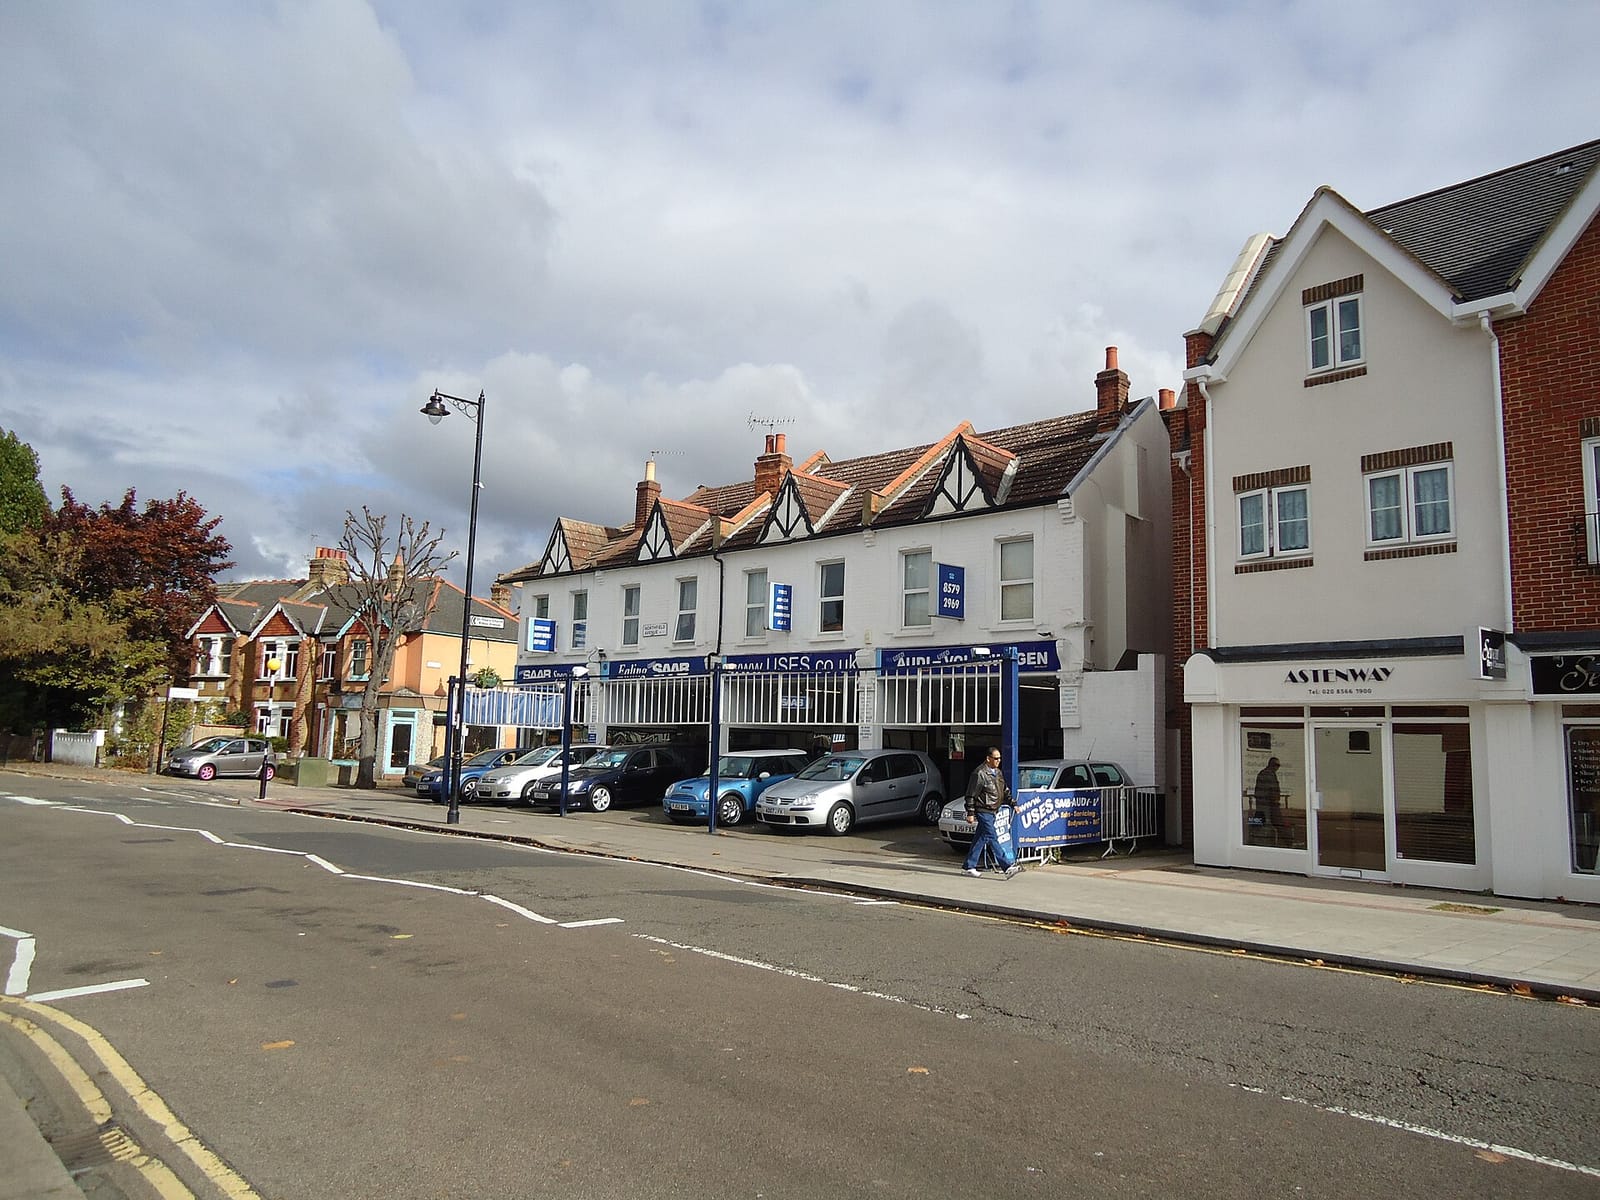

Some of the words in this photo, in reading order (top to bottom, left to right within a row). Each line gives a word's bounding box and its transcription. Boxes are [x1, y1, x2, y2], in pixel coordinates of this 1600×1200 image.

[943, 582, 960, 595] 8579
[943, 597, 960, 609] 2969
[652, 662, 690, 676] SAAB
[1284, 667, 1395, 683] ASTENWAY
[1021, 798, 1055, 829] USES
